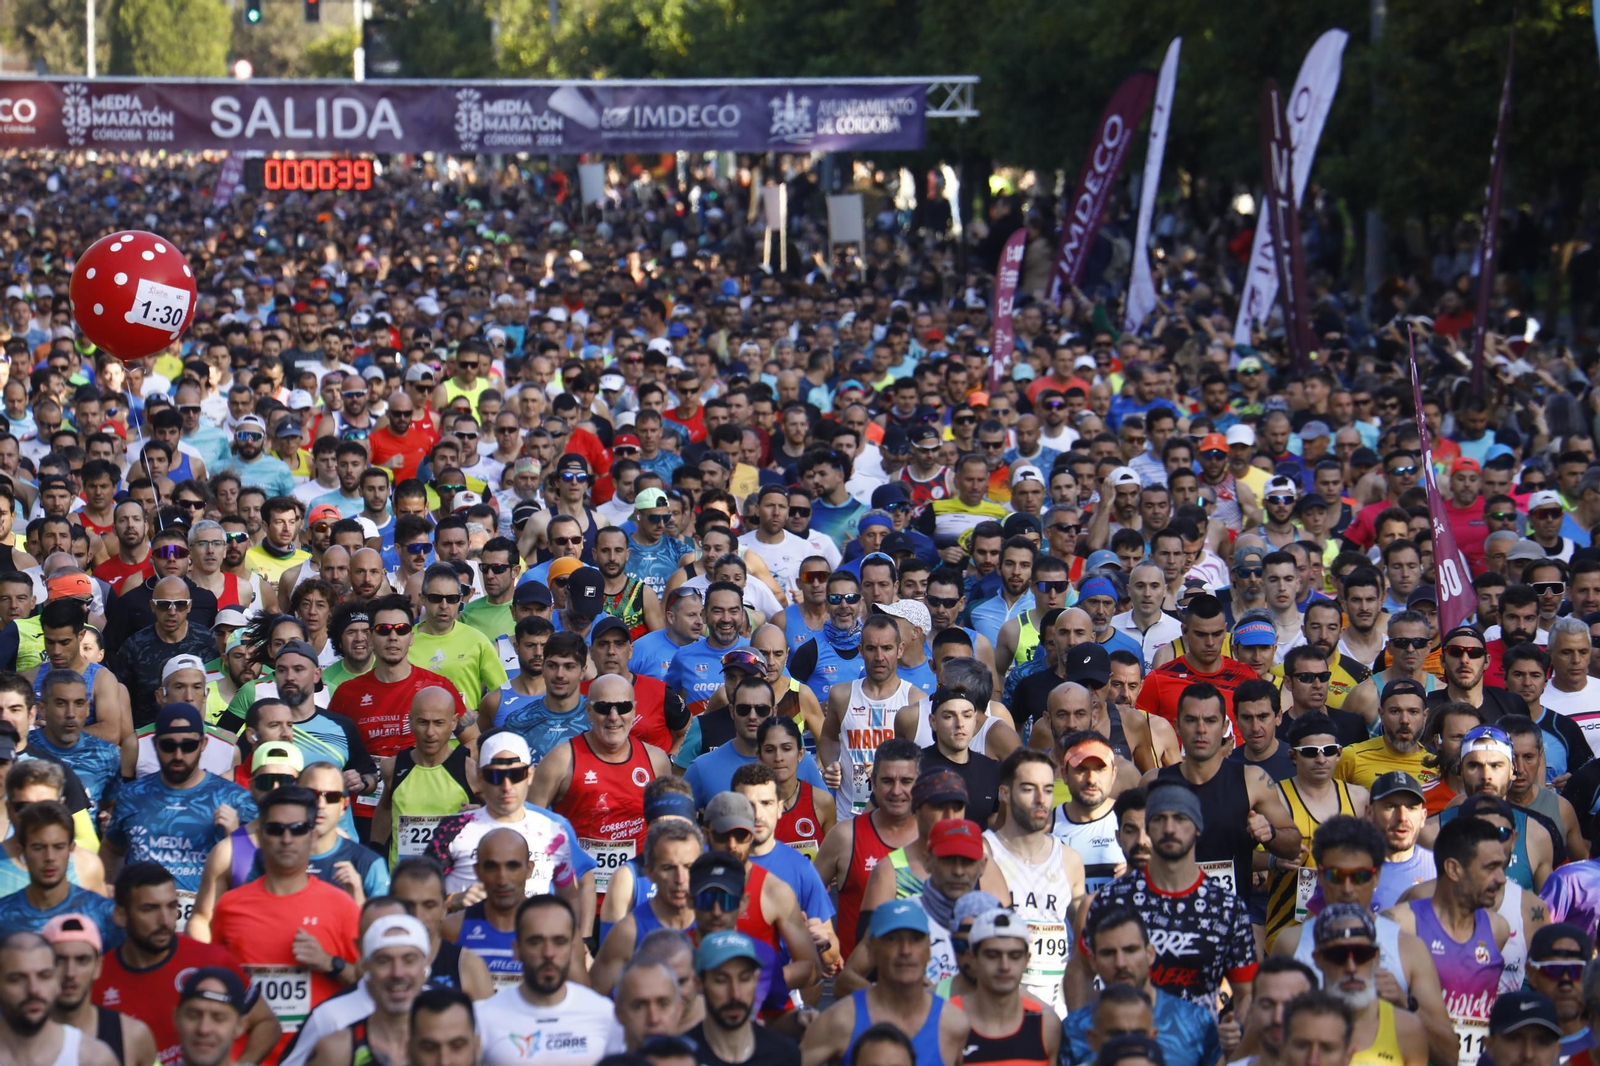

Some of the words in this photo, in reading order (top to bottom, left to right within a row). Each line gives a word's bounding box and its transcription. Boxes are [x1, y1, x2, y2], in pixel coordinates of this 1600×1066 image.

[62, 105, 91, 127] 38
[92, 105, 174, 126] MARATÓN
[633, 104, 741, 127] IMDECO
[816, 97, 917, 116] AYUNTAMIENTO
[211, 97, 403, 140] SALIDA
[455, 112, 483, 132] 38
[484, 110, 563, 131] MARATÓN
[816, 118, 834, 134] DE
[92, 130, 142, 141] CÓRDOBA
[147, 130, 174, 141] 2024
[484, 133, 532, 145] CÓRDOBA
[537, 133, 562, 145] 2024
[1059, 113, 1124, 274] IMDECO
[141, 300, 183, 326] 1:30
[366, 715, 400, 723] GENERALI
[368, 727, 401, 739] MÁLAGA
[149, 836, 193, 850] MEDIA
[546, 1037, 588, 1051] CORRE
